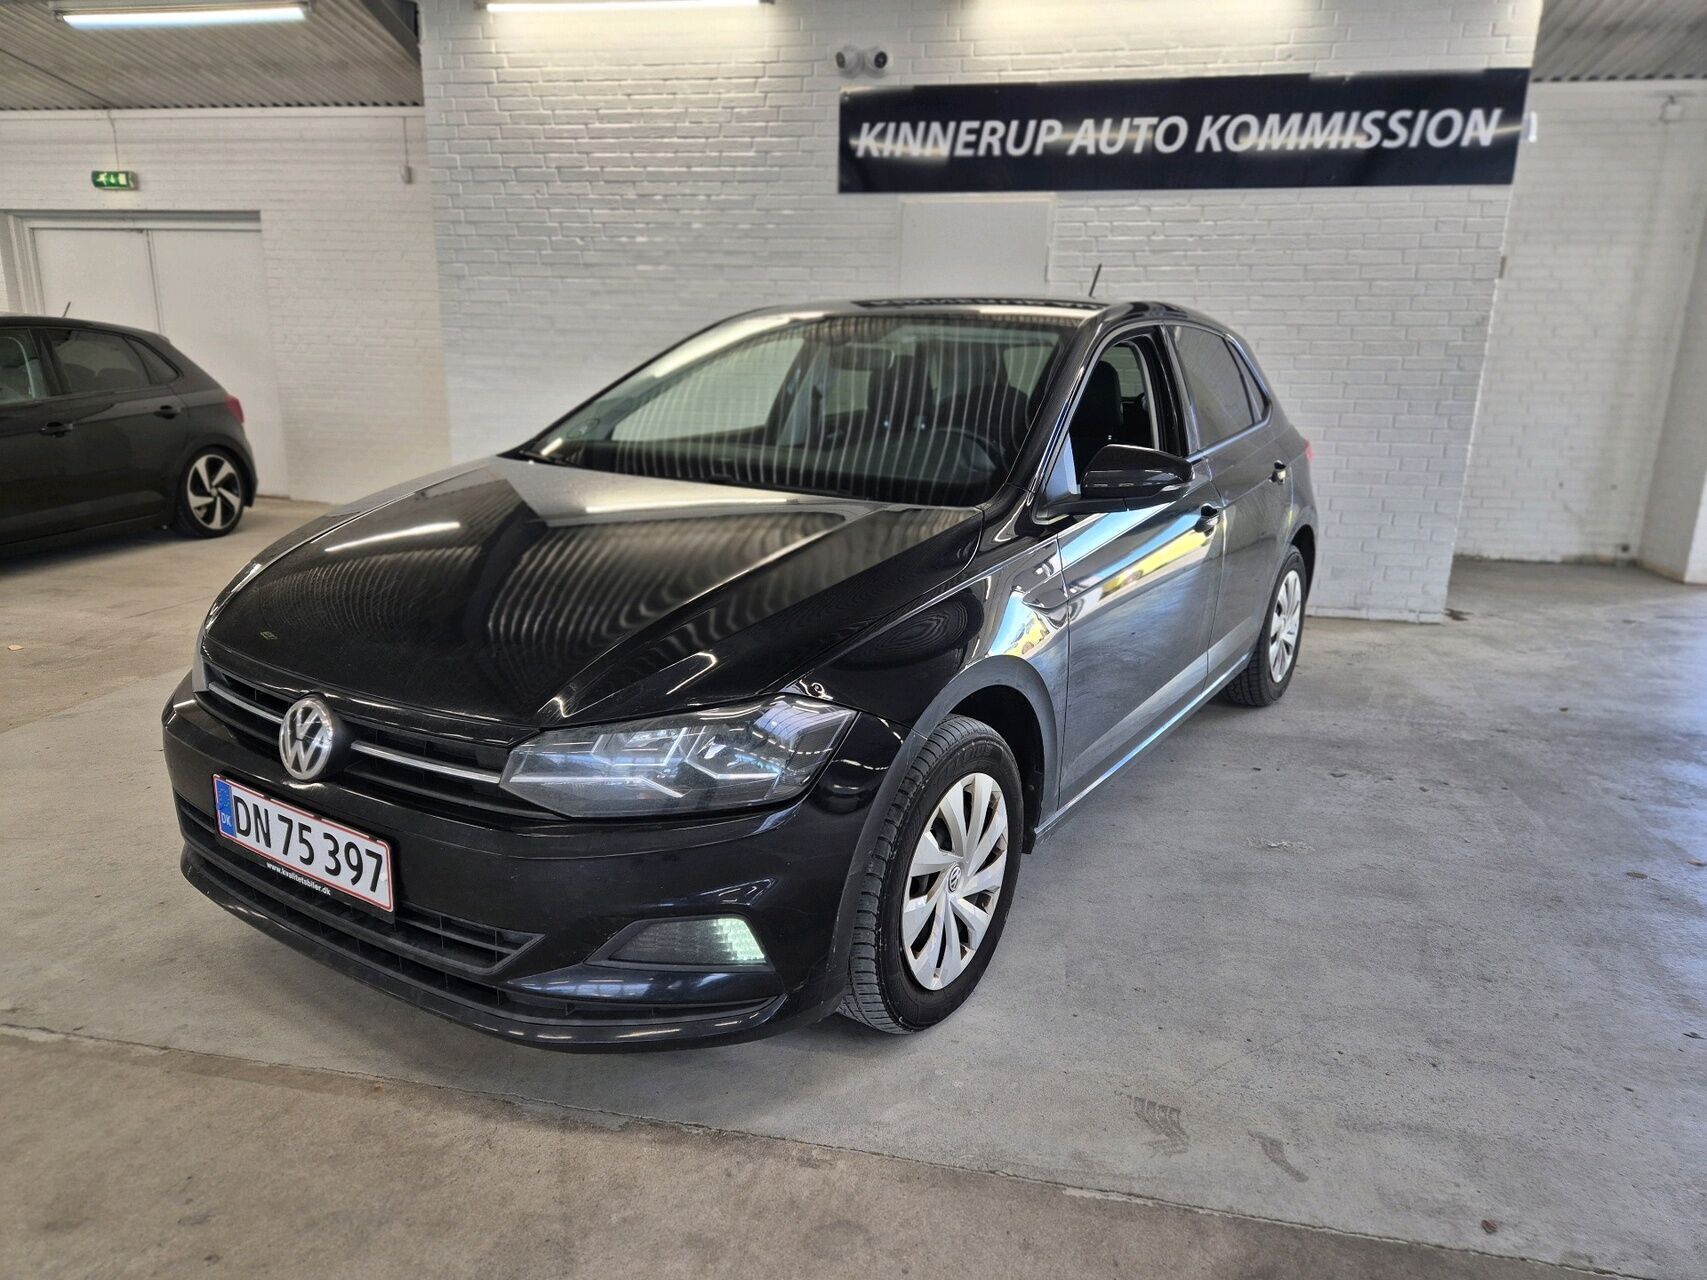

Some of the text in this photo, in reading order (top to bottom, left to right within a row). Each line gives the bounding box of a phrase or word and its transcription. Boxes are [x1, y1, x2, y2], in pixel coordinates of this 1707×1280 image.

[856, 108, 1503, 158] KINNERUP AUTO KOMMISSION
[221, 812, 232, 827] DK
[233, 795, 383, 893] DN 75 397
